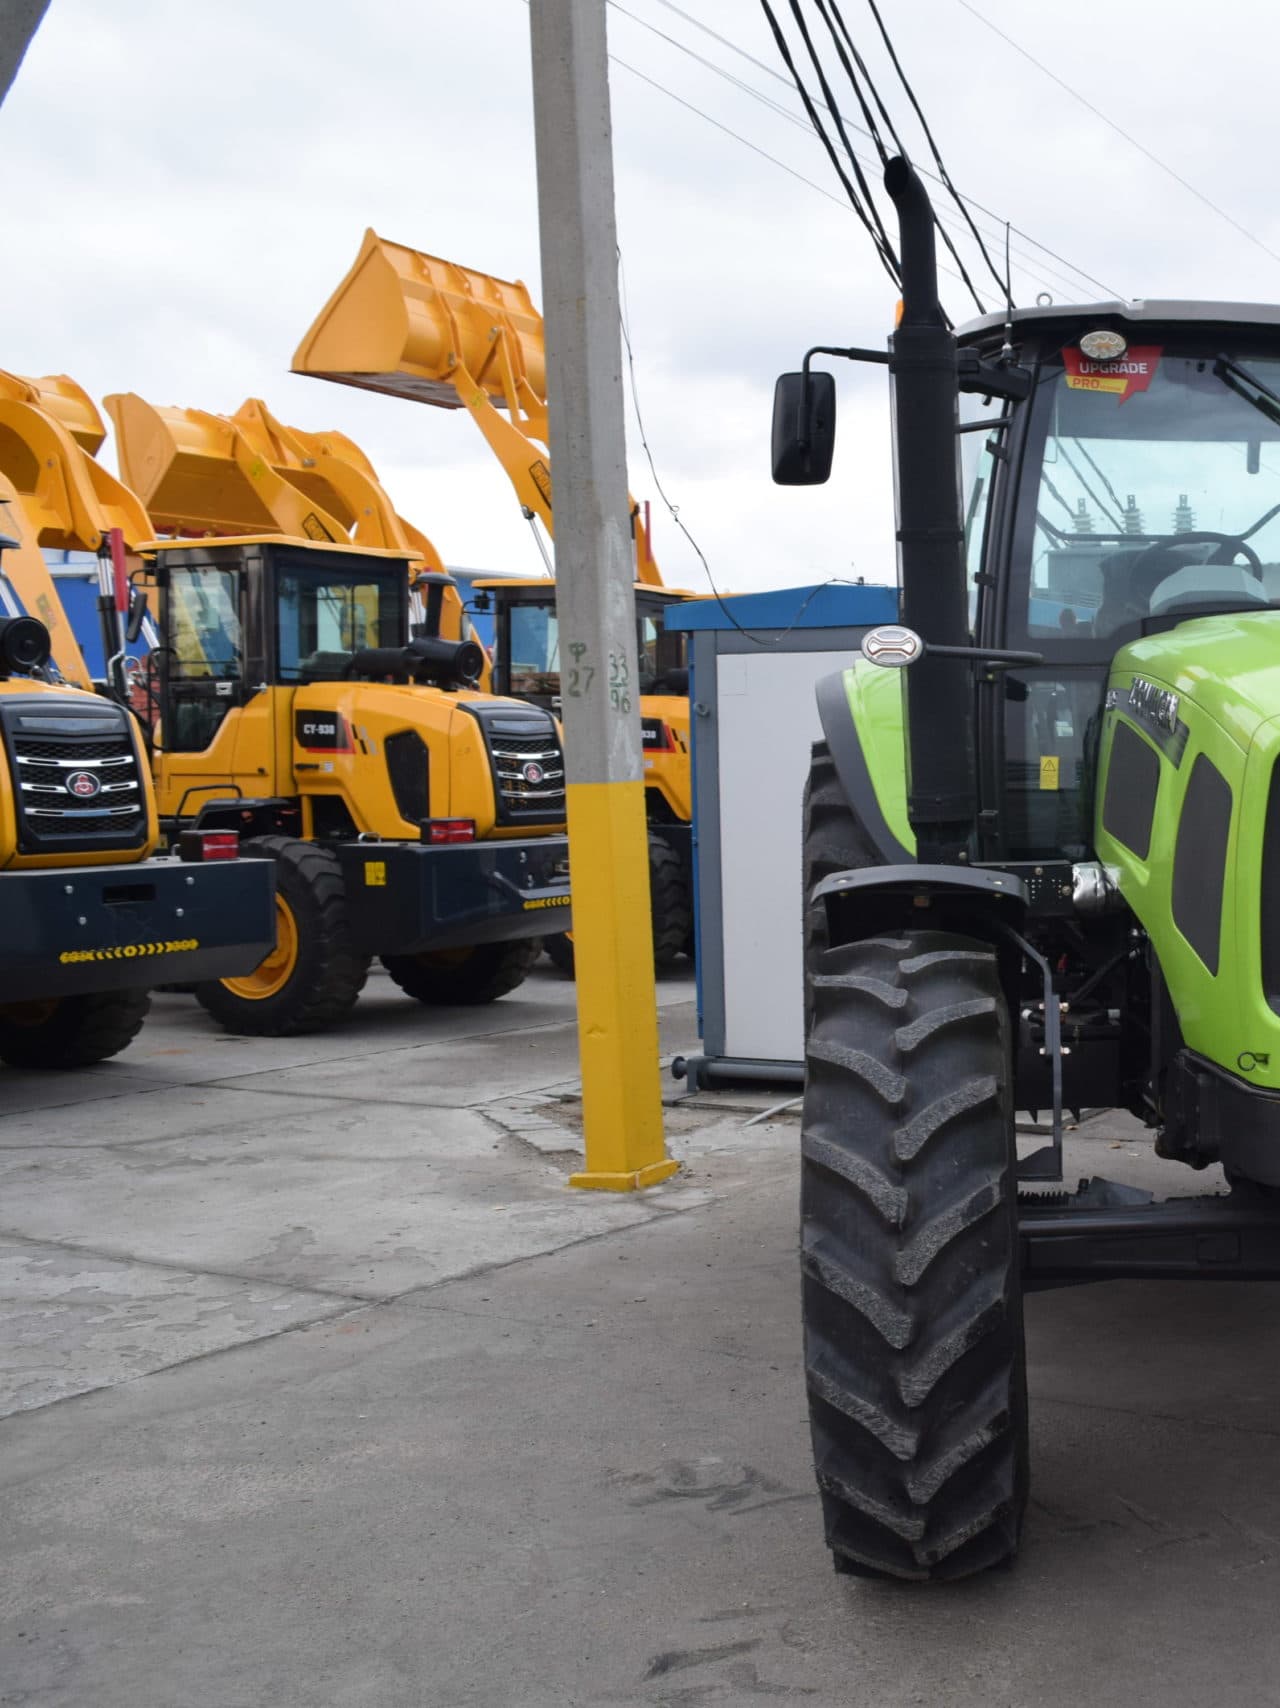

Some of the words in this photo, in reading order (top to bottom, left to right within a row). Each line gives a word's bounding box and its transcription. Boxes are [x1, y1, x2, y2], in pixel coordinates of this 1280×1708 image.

[1080, 363, 1148, 374] UPGRADE
[1072, 378, 1100, 389] PRO
[567, 666, 595, 698] 27
